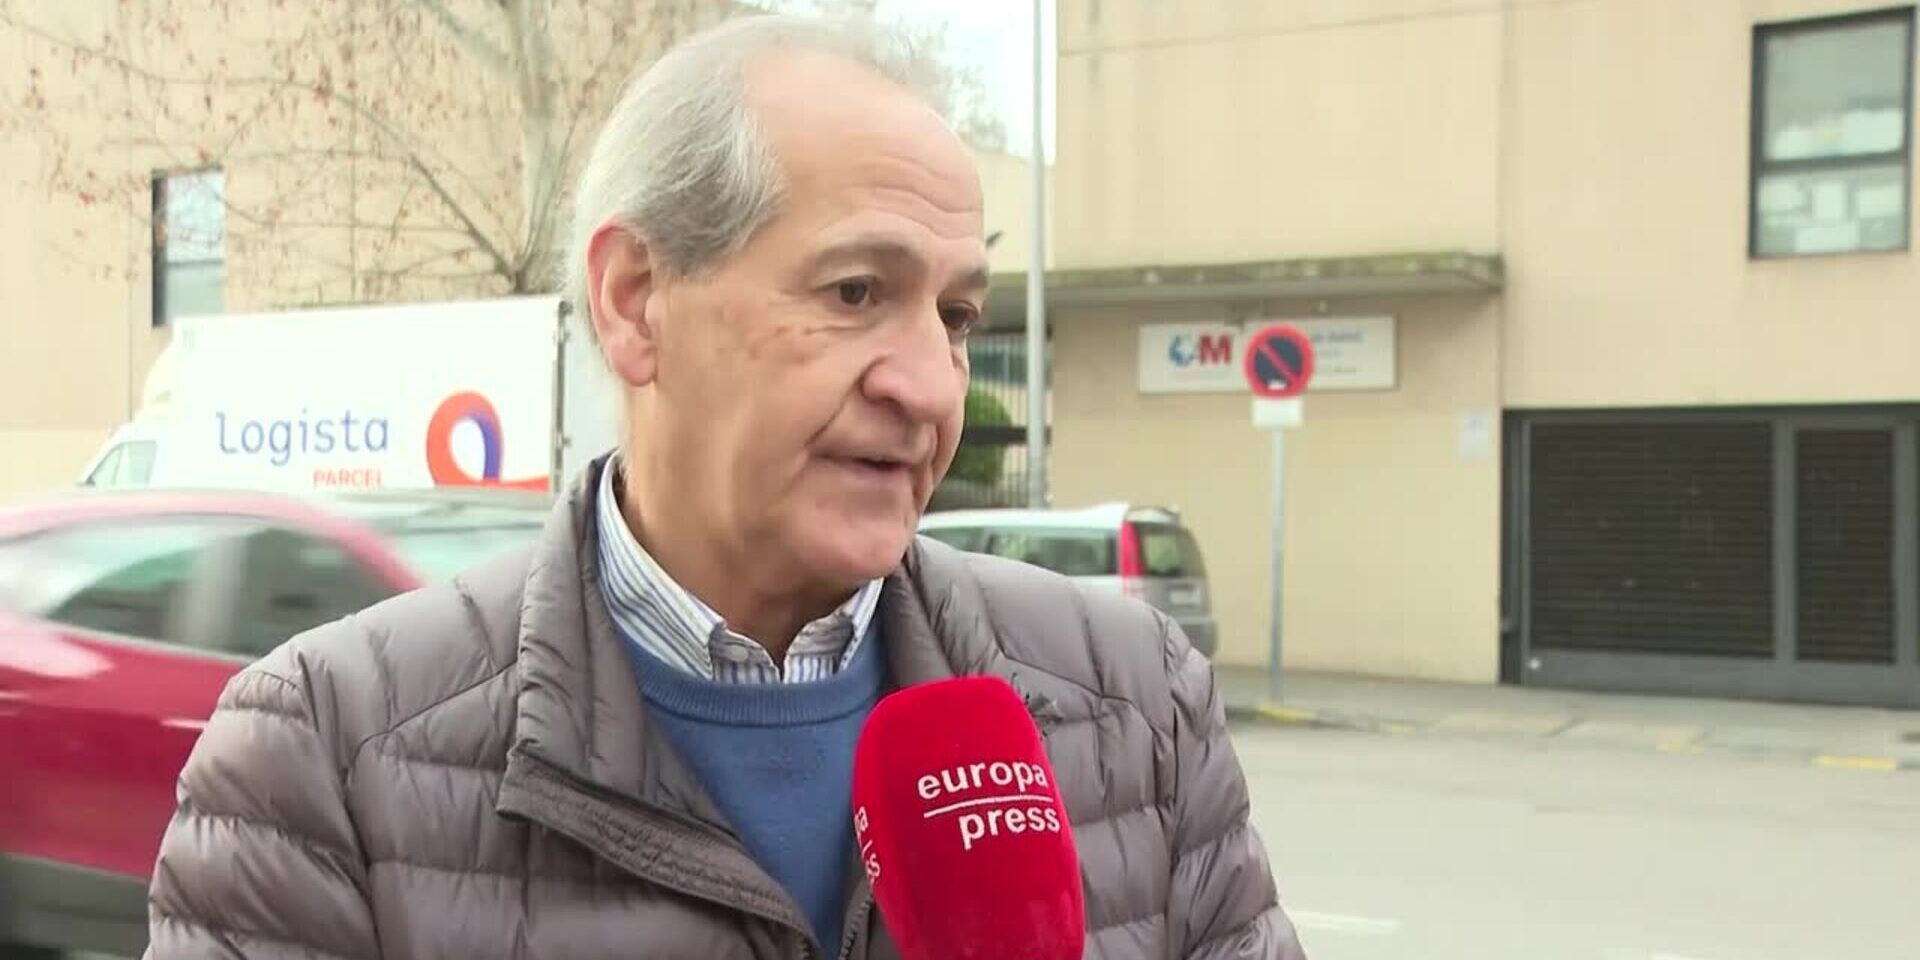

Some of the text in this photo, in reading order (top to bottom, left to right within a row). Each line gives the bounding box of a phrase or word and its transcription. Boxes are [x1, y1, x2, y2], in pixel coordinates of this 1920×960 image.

[1199, 335, 1231, 365] M
[917, 761, 1049, 800] europa
[959, 806, 1061, 850] press
